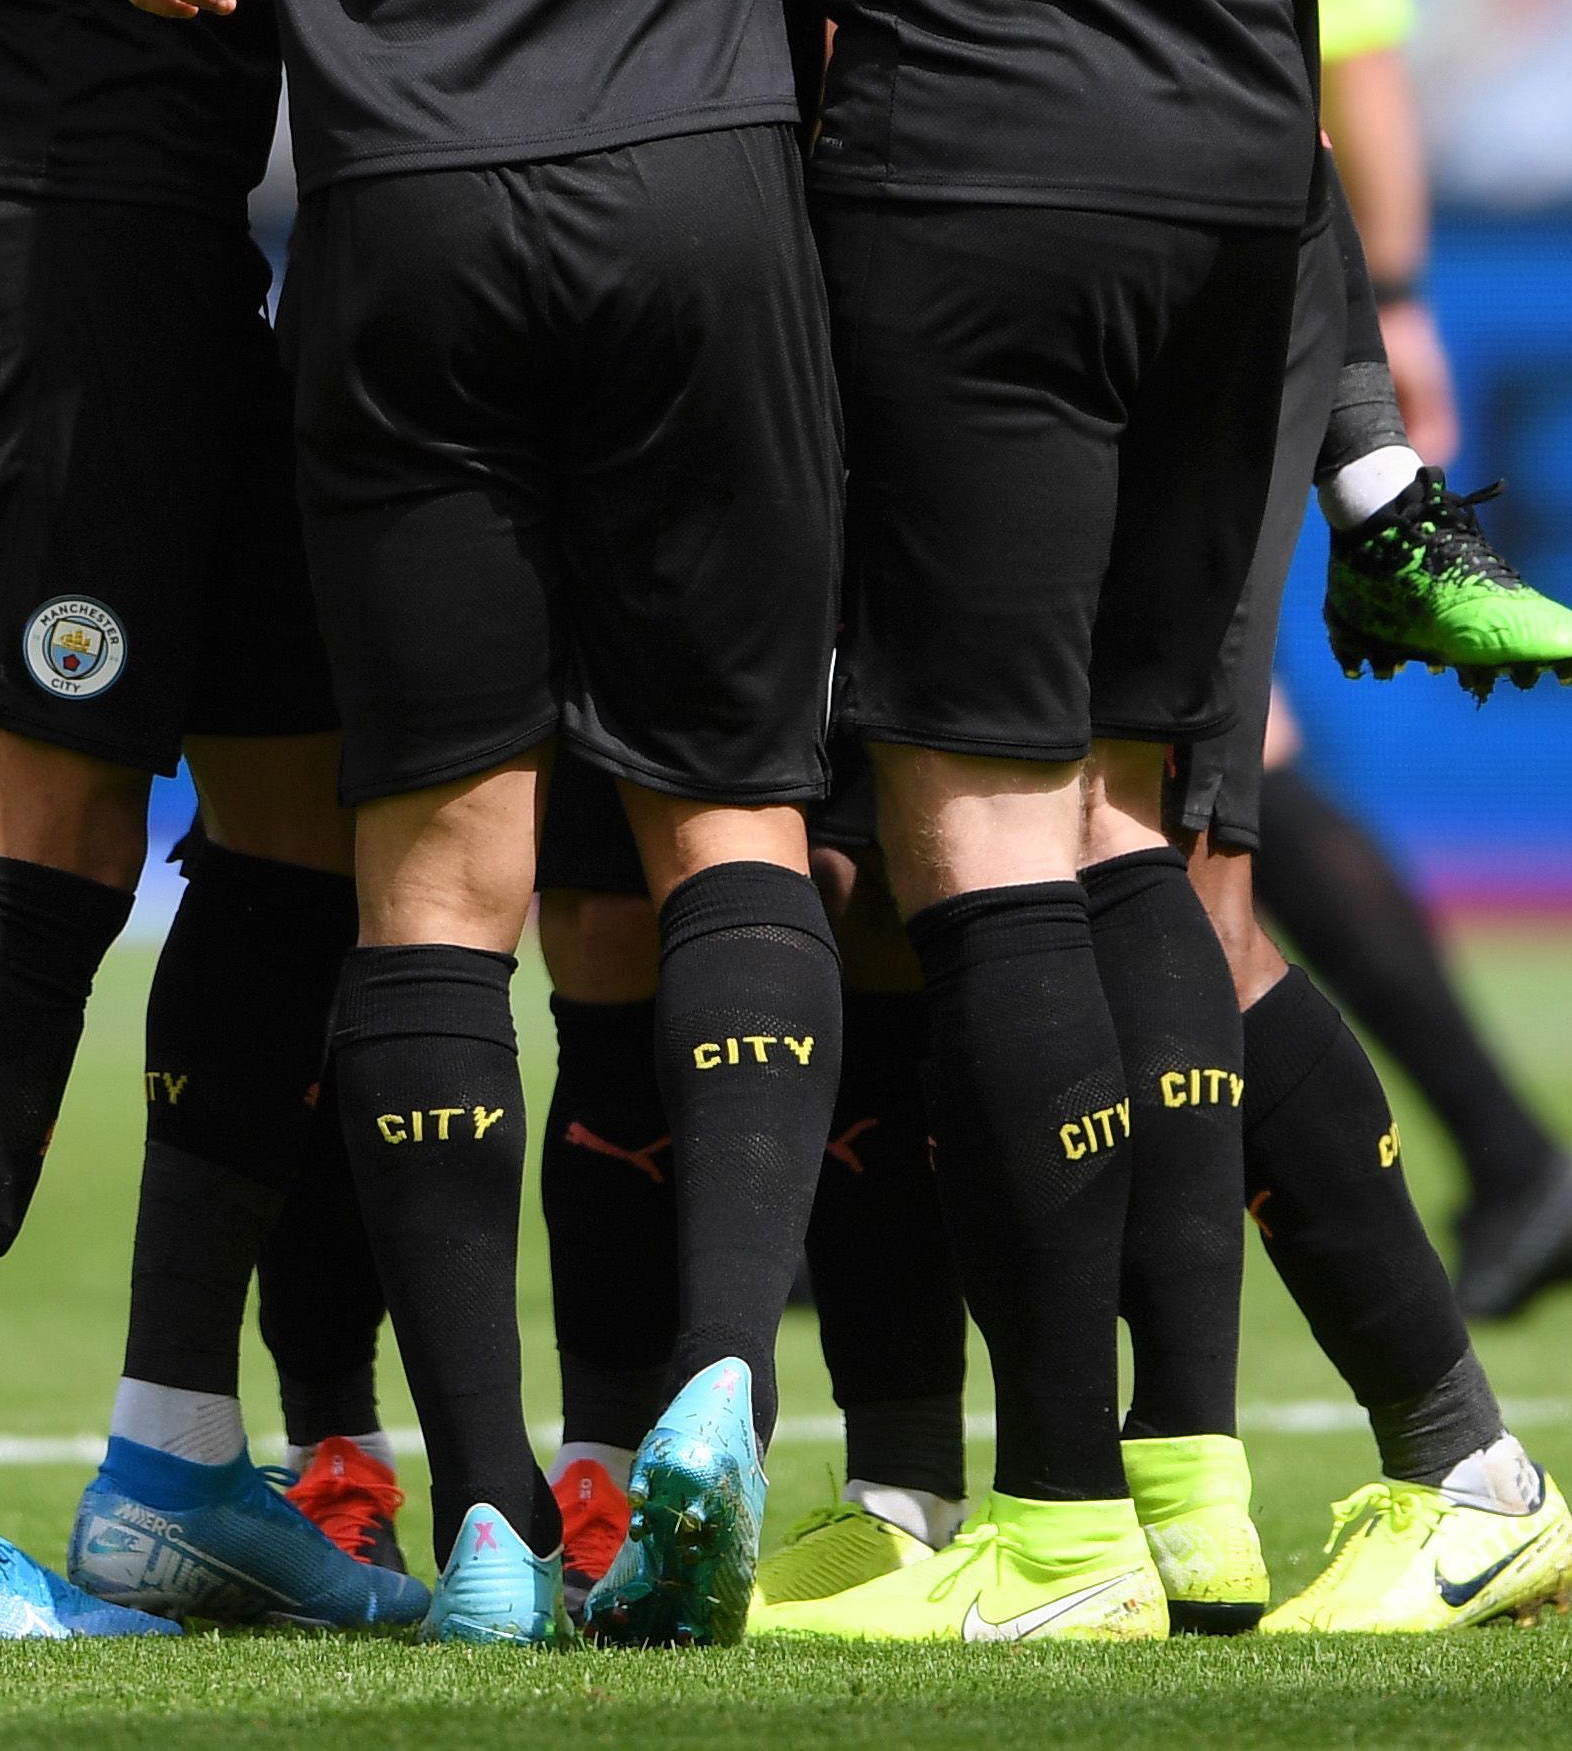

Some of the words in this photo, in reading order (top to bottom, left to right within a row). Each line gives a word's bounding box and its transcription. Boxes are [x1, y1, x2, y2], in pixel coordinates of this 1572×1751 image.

[40, 603, 120, 646] MANCHESTER
[50, 678, 82, 693] CITY
[693, 1035, 815, 1070] CITY
[1160, 1068, 1245, 1108] CITY
[376, 1105, 505, 1145] CITY
[1059, 1096, 1130, 1160] CITY
[1378, 1121, 1401, 1168] CI
